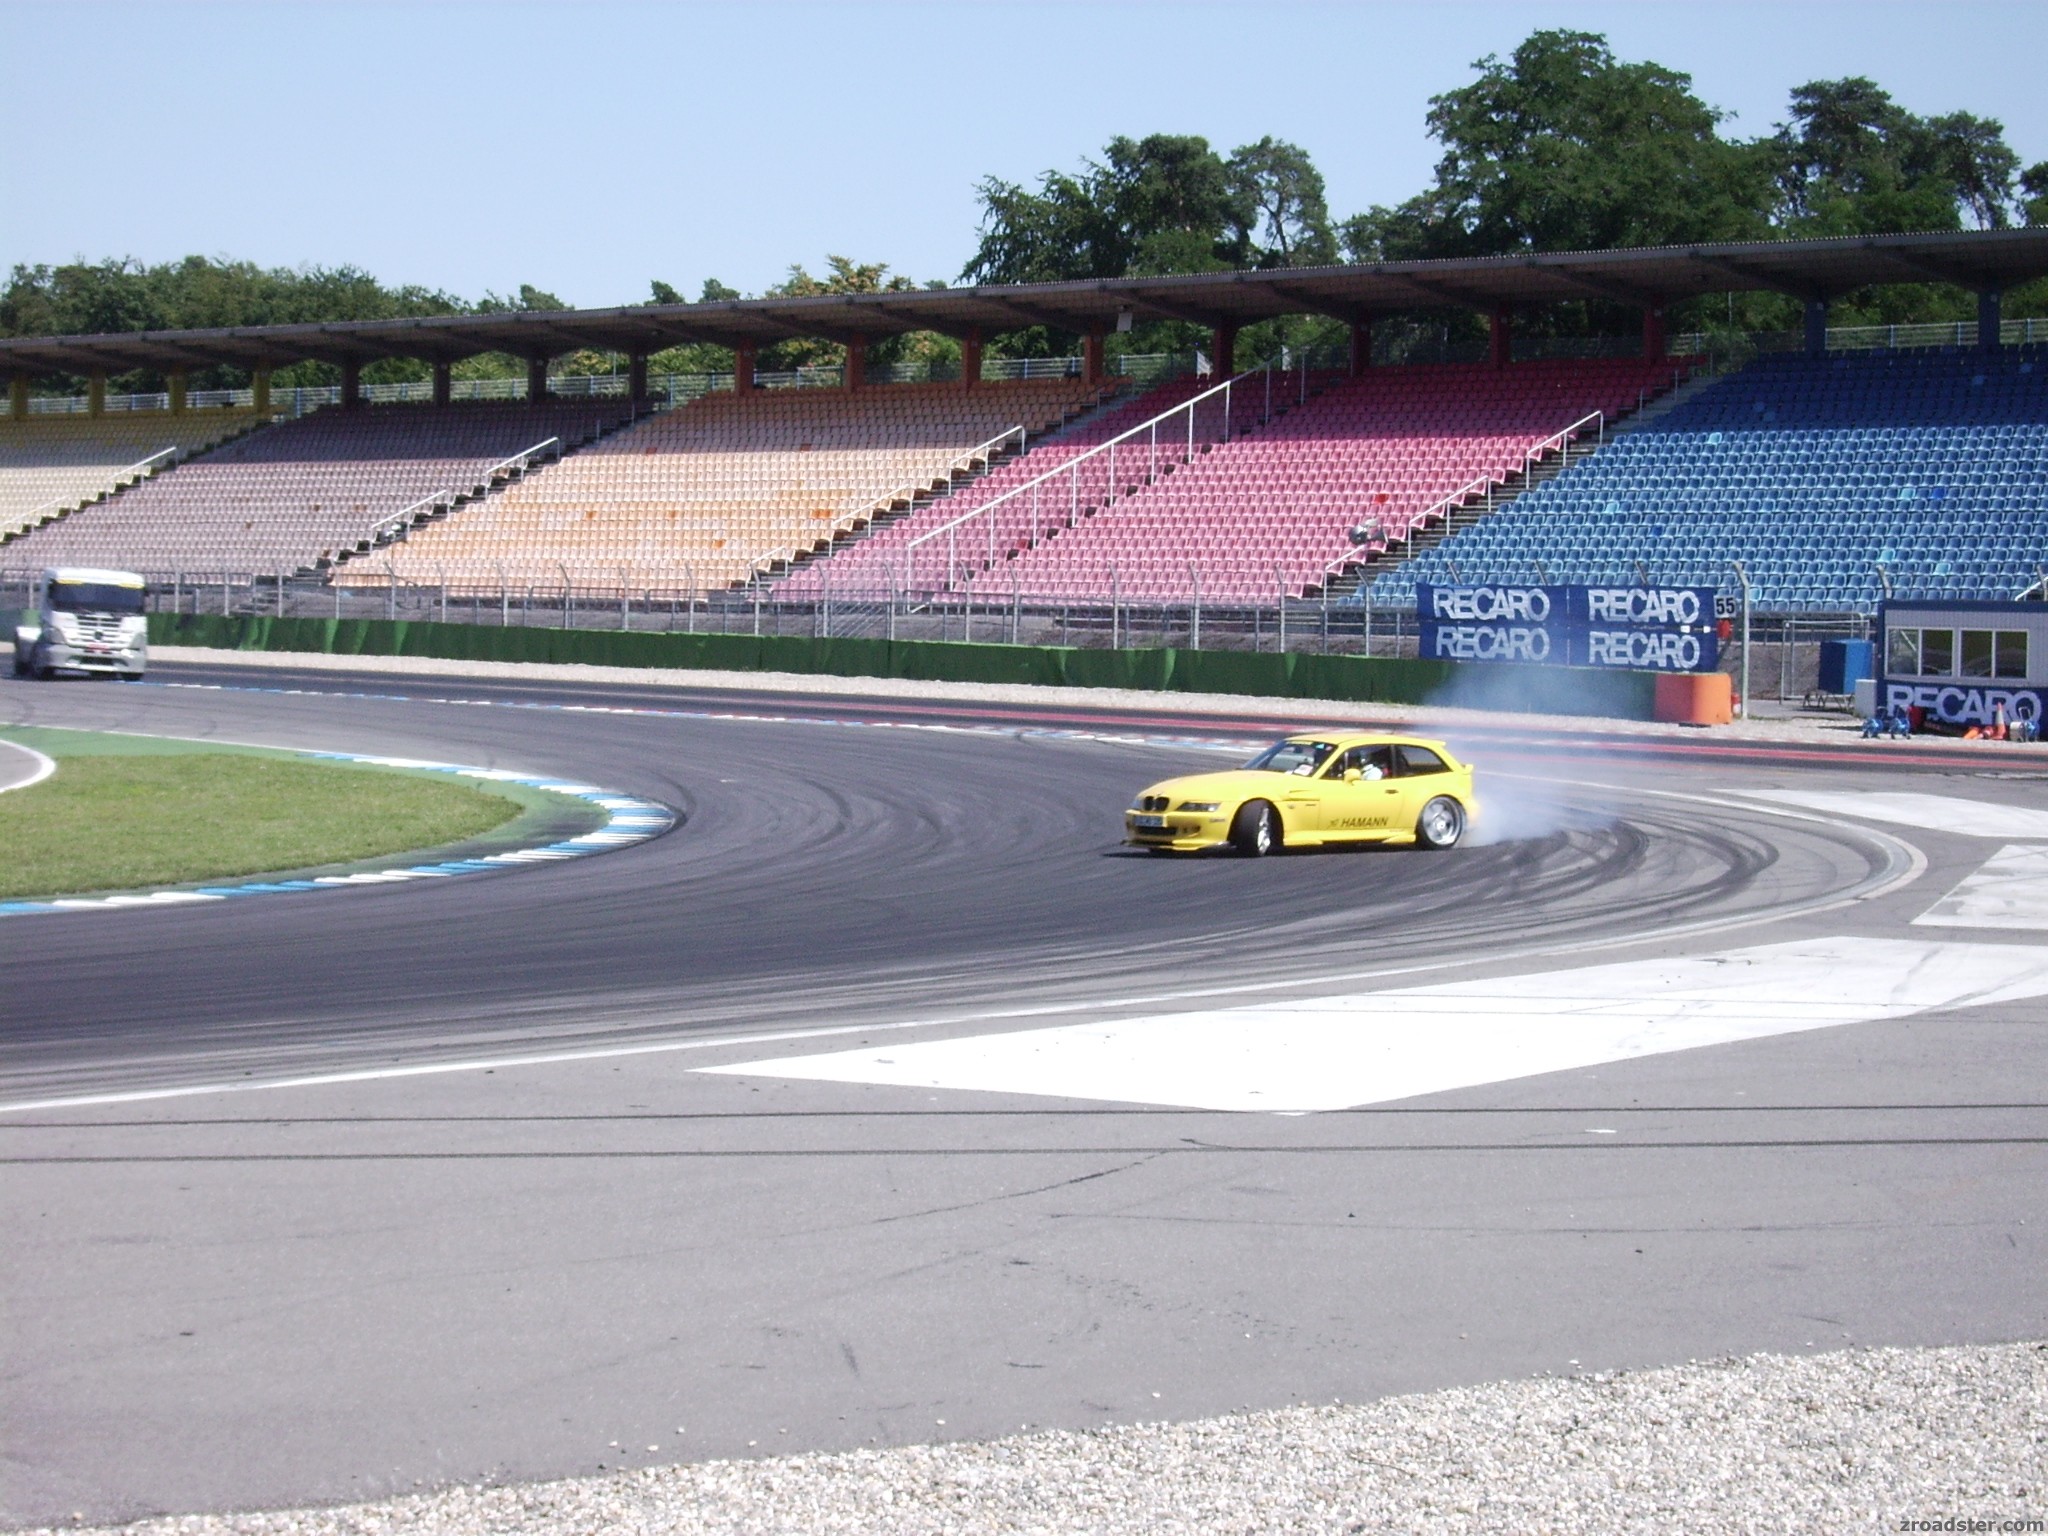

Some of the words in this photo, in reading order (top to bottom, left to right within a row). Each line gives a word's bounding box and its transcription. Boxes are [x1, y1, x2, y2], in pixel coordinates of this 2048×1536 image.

[1433, 588, 1550, 621] RECARO
[1588, 589, 1700, 624] RECARO
[1716, 598, 1735, 615] 55
[1436, 626, 1550, 660] RECARO
[1588, 631, 1700, 668] RECARO
[1887, 685, 2042, 723] RECARO
[1341, 816, 1388, 827] HAMANN
